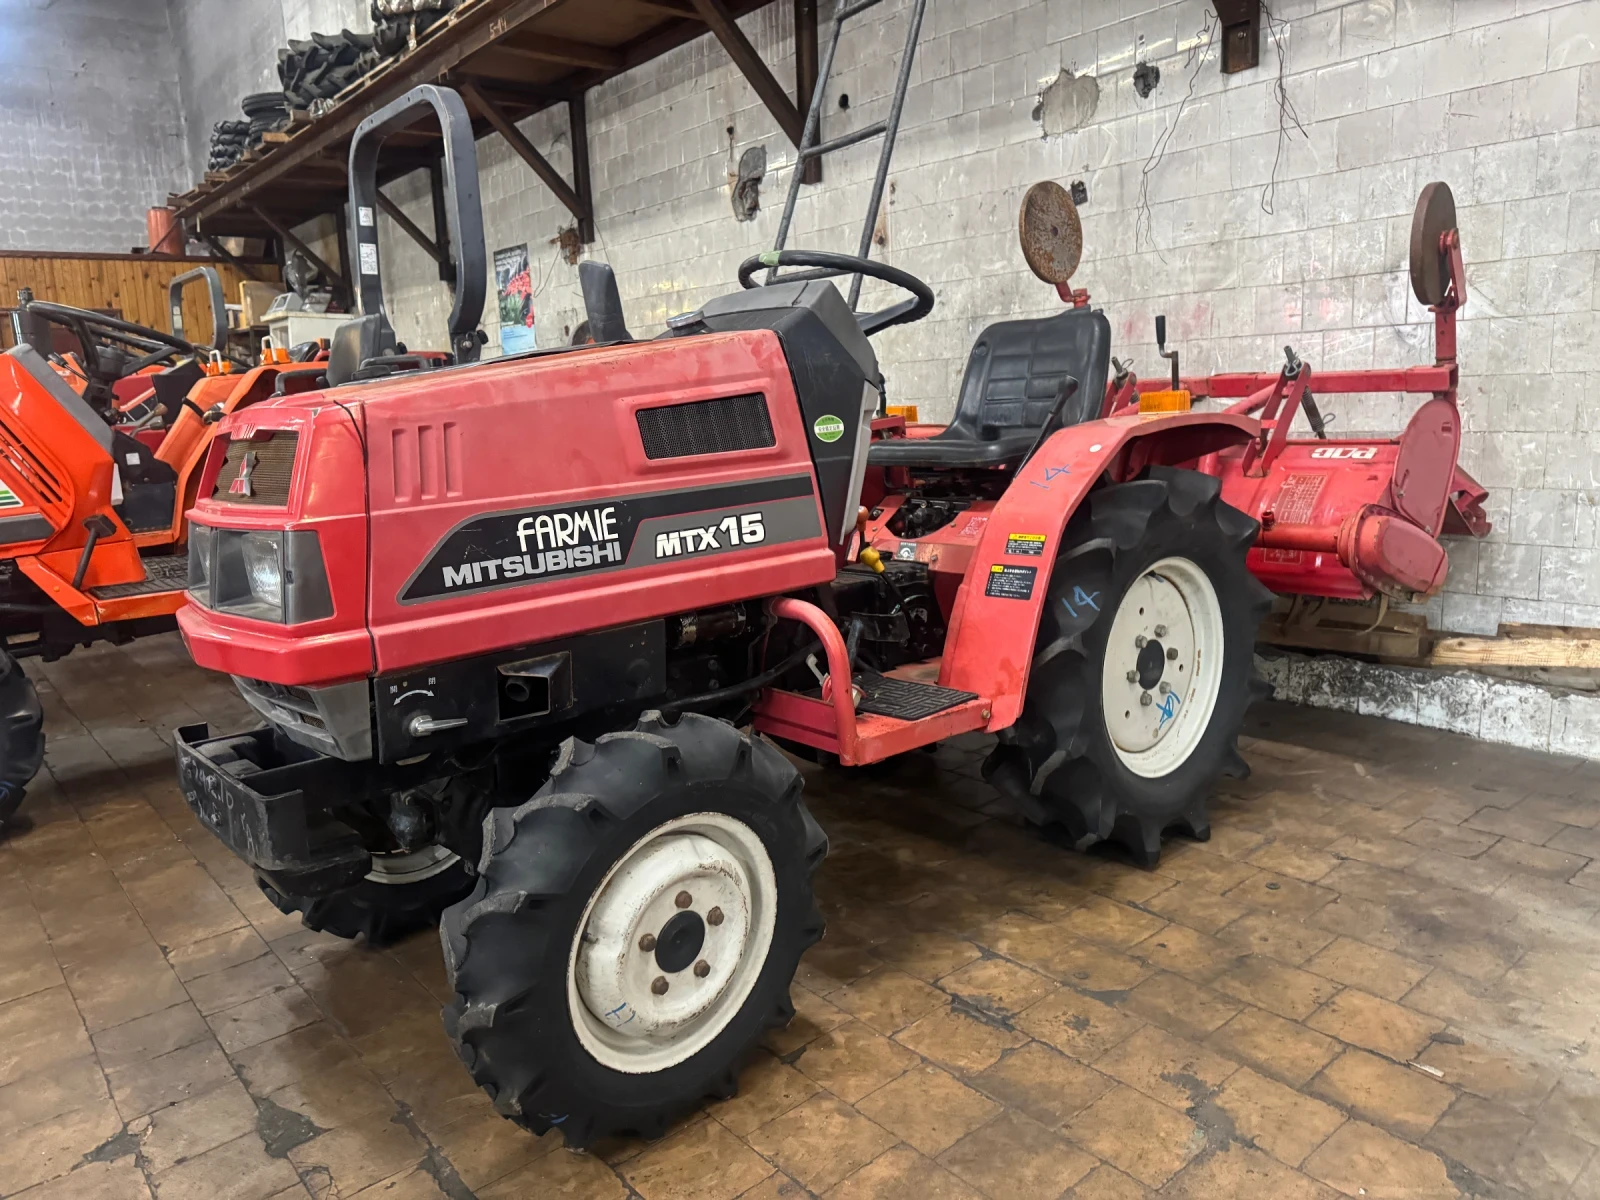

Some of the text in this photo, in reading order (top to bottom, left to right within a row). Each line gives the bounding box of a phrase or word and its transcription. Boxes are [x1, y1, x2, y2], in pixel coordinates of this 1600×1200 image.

[1030, 464, 1072, 489] 14
[516, 506, 619, 552] FARMIE
[442, 541, 622, 588] MITSUBISHI
[1061, 585, 1101, 618] 14
